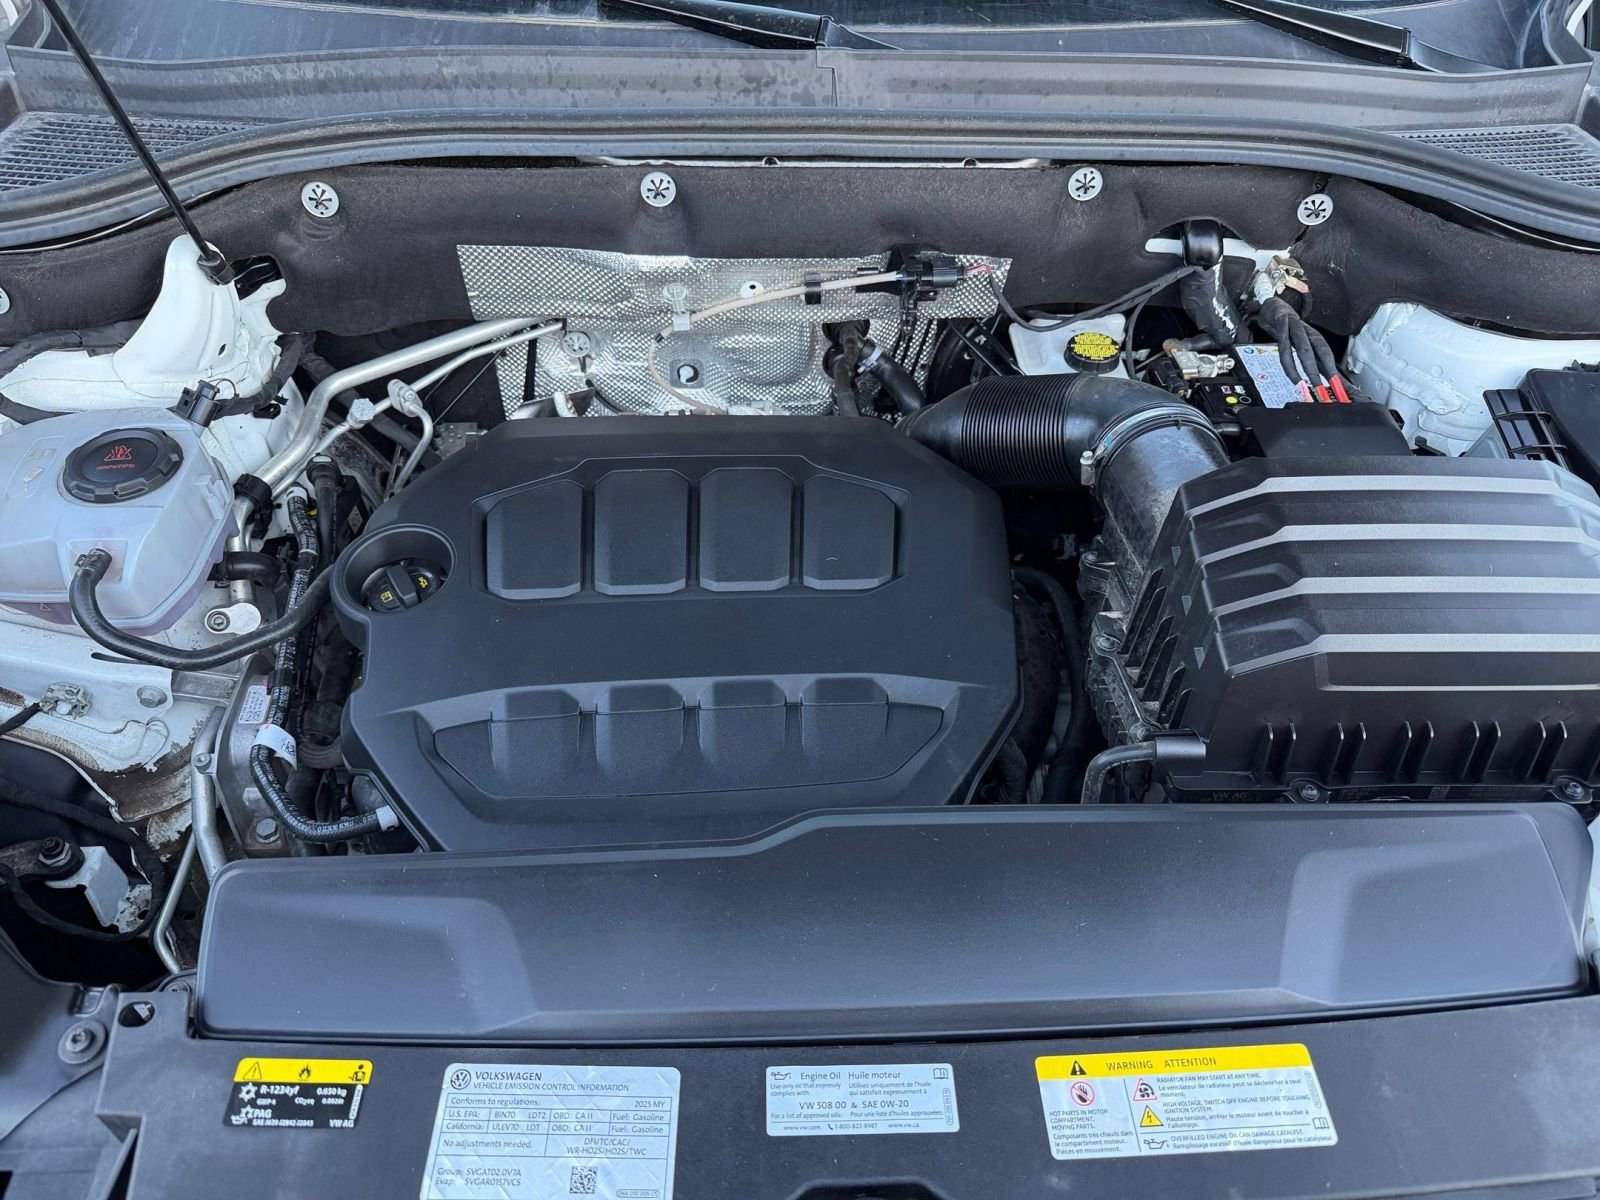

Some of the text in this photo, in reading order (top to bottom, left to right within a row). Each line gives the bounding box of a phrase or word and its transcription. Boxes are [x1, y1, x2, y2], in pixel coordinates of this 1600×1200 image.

[1106, 1057, 1216, 1071] WARNING ATTENTION
[475, 1071, 542, 1081] VOLKSWAGEN
[800, 1071, 841, 1082] Engine Oil
[848, 1071, 901, 1079] Huile moteur
[260, 1084, 300, 1097] R-1234yf
[504, 1082, 540, 1090] EMISSION
[542, 1083, 575, 1091] CONTROL
[578, 1084, 630, 1092] INFORMATION
[451, 1096, 486, 1105] Conforms
[634, 1100, 665, 1108] 2025 MY
[799, 1101, 815, 1110] VW
[817, 1101, 833, 1110] 508
[834, 1101, 847, 1109] 00
[862, 1100, 878, 1109] SAE
[879, 1099, 909, 1108] 0W-20
[253, 1108, 273, 1118] PAG
[528, 1111, 546, 1119] LDT2
[553, 1112, 585, 1120] OBD: CA
[613, 1113, 665, 1121] Fuel: Gasoline
[329, 1119, 355, 1128] VW AG
[611, 1125, 664, 1134] Fuel: Gasoline
[443, 1139, 532, 1150] No adjustments needed.
[437, 1167, 463, 1177] Group:
[435, 1177, 456, 1187] Evap:
